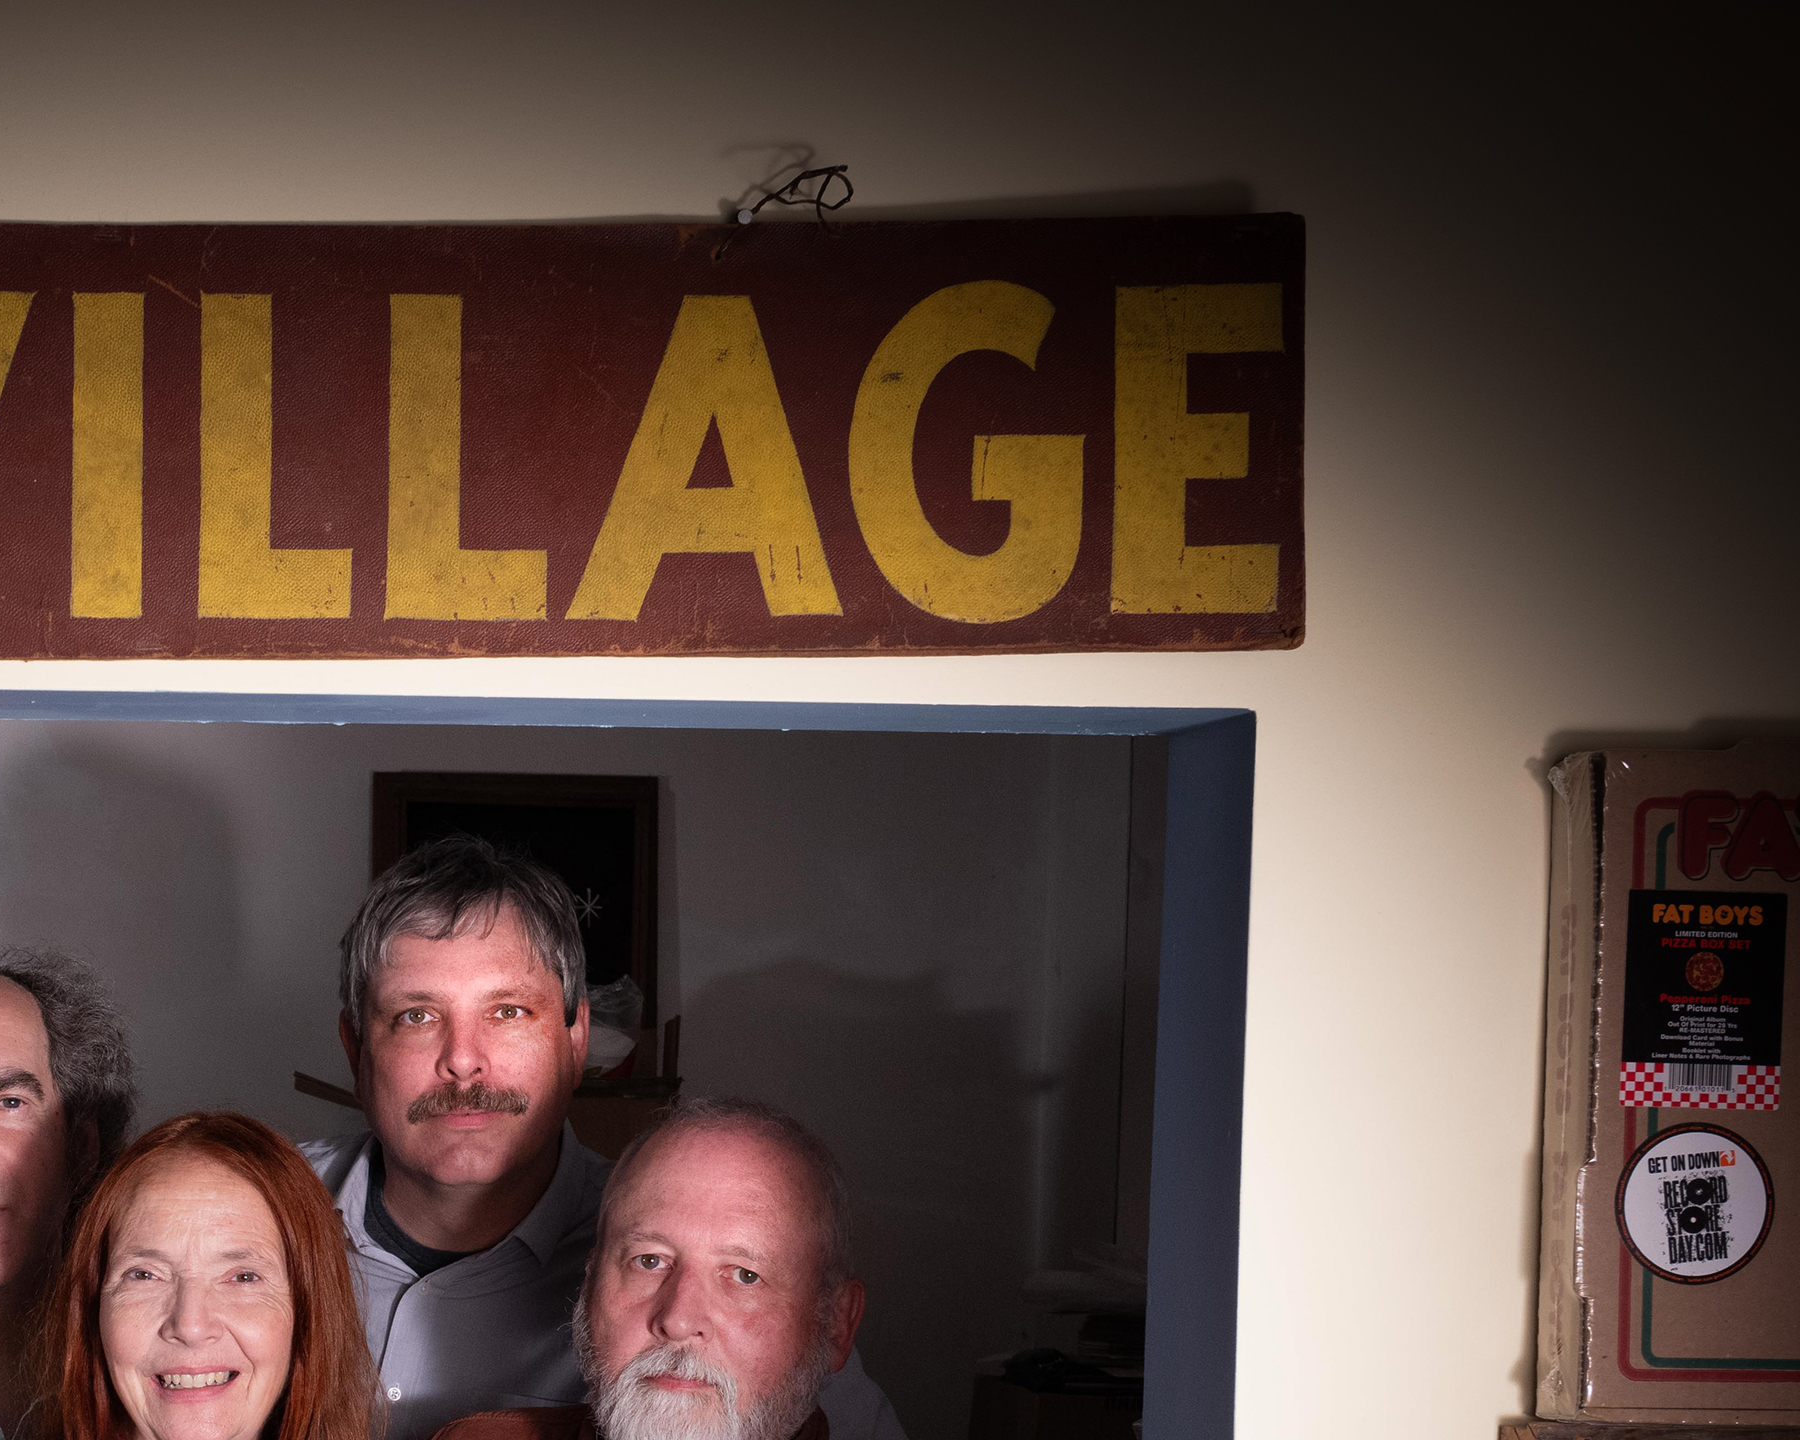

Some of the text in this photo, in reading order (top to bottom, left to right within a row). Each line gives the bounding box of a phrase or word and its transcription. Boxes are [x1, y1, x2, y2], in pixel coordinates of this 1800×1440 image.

[1652, 903, 1764, 926] FAT BOYS
[1661, 938, 1751, 950] PIZZA BOX SET
[1675, 930, 1706, 938] LIMITED
[1659, 993, 1751, 1006] Pepperoni Pizza
[1687, 1005, 1739, 1013] Picture Disc
[1647, 1151, 1721, 1174] GET ON DOWN
[1663, 1175, 1729, 1209] RECORD
[1666, 1204, 1723, 1236] STORE
[1668, 1232, 1729, 1264] DAY.COM
